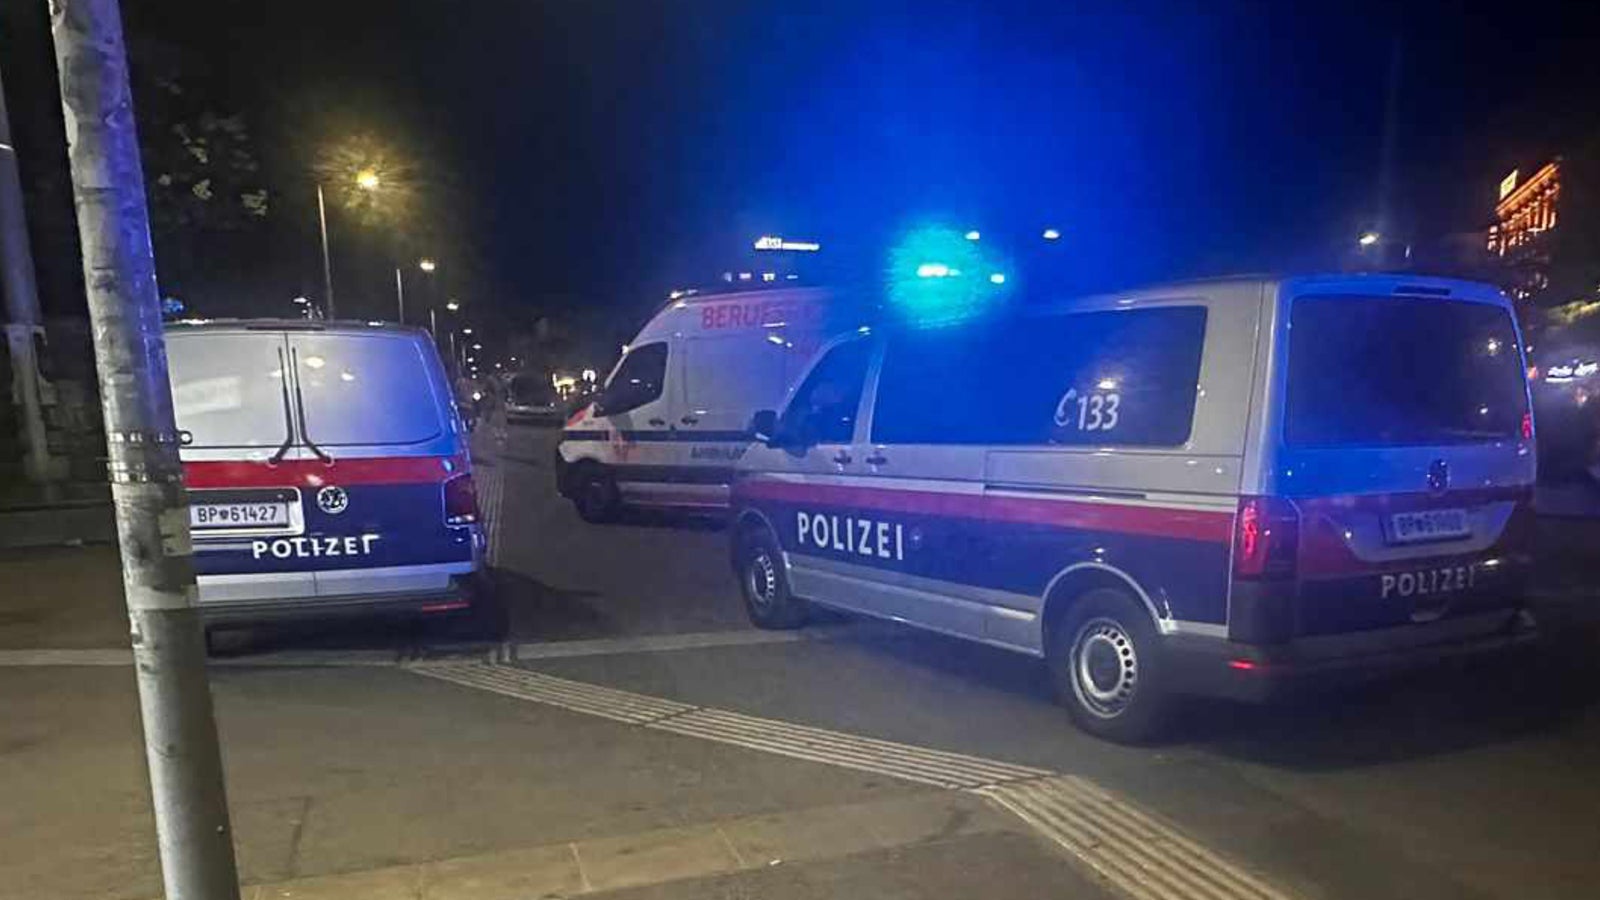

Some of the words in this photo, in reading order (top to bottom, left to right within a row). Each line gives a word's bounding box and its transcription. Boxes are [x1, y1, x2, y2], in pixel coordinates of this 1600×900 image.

[1077, 394, 1120, 430] 133
[197, 507, 218, 523] BP
[230, 506, 278, 522] 61427
[252, 534, 380, 559] POLIZEI
[797, 511, 903, 560] POLIZEI
[1381, 565, 1475, 599] POLIZEI
